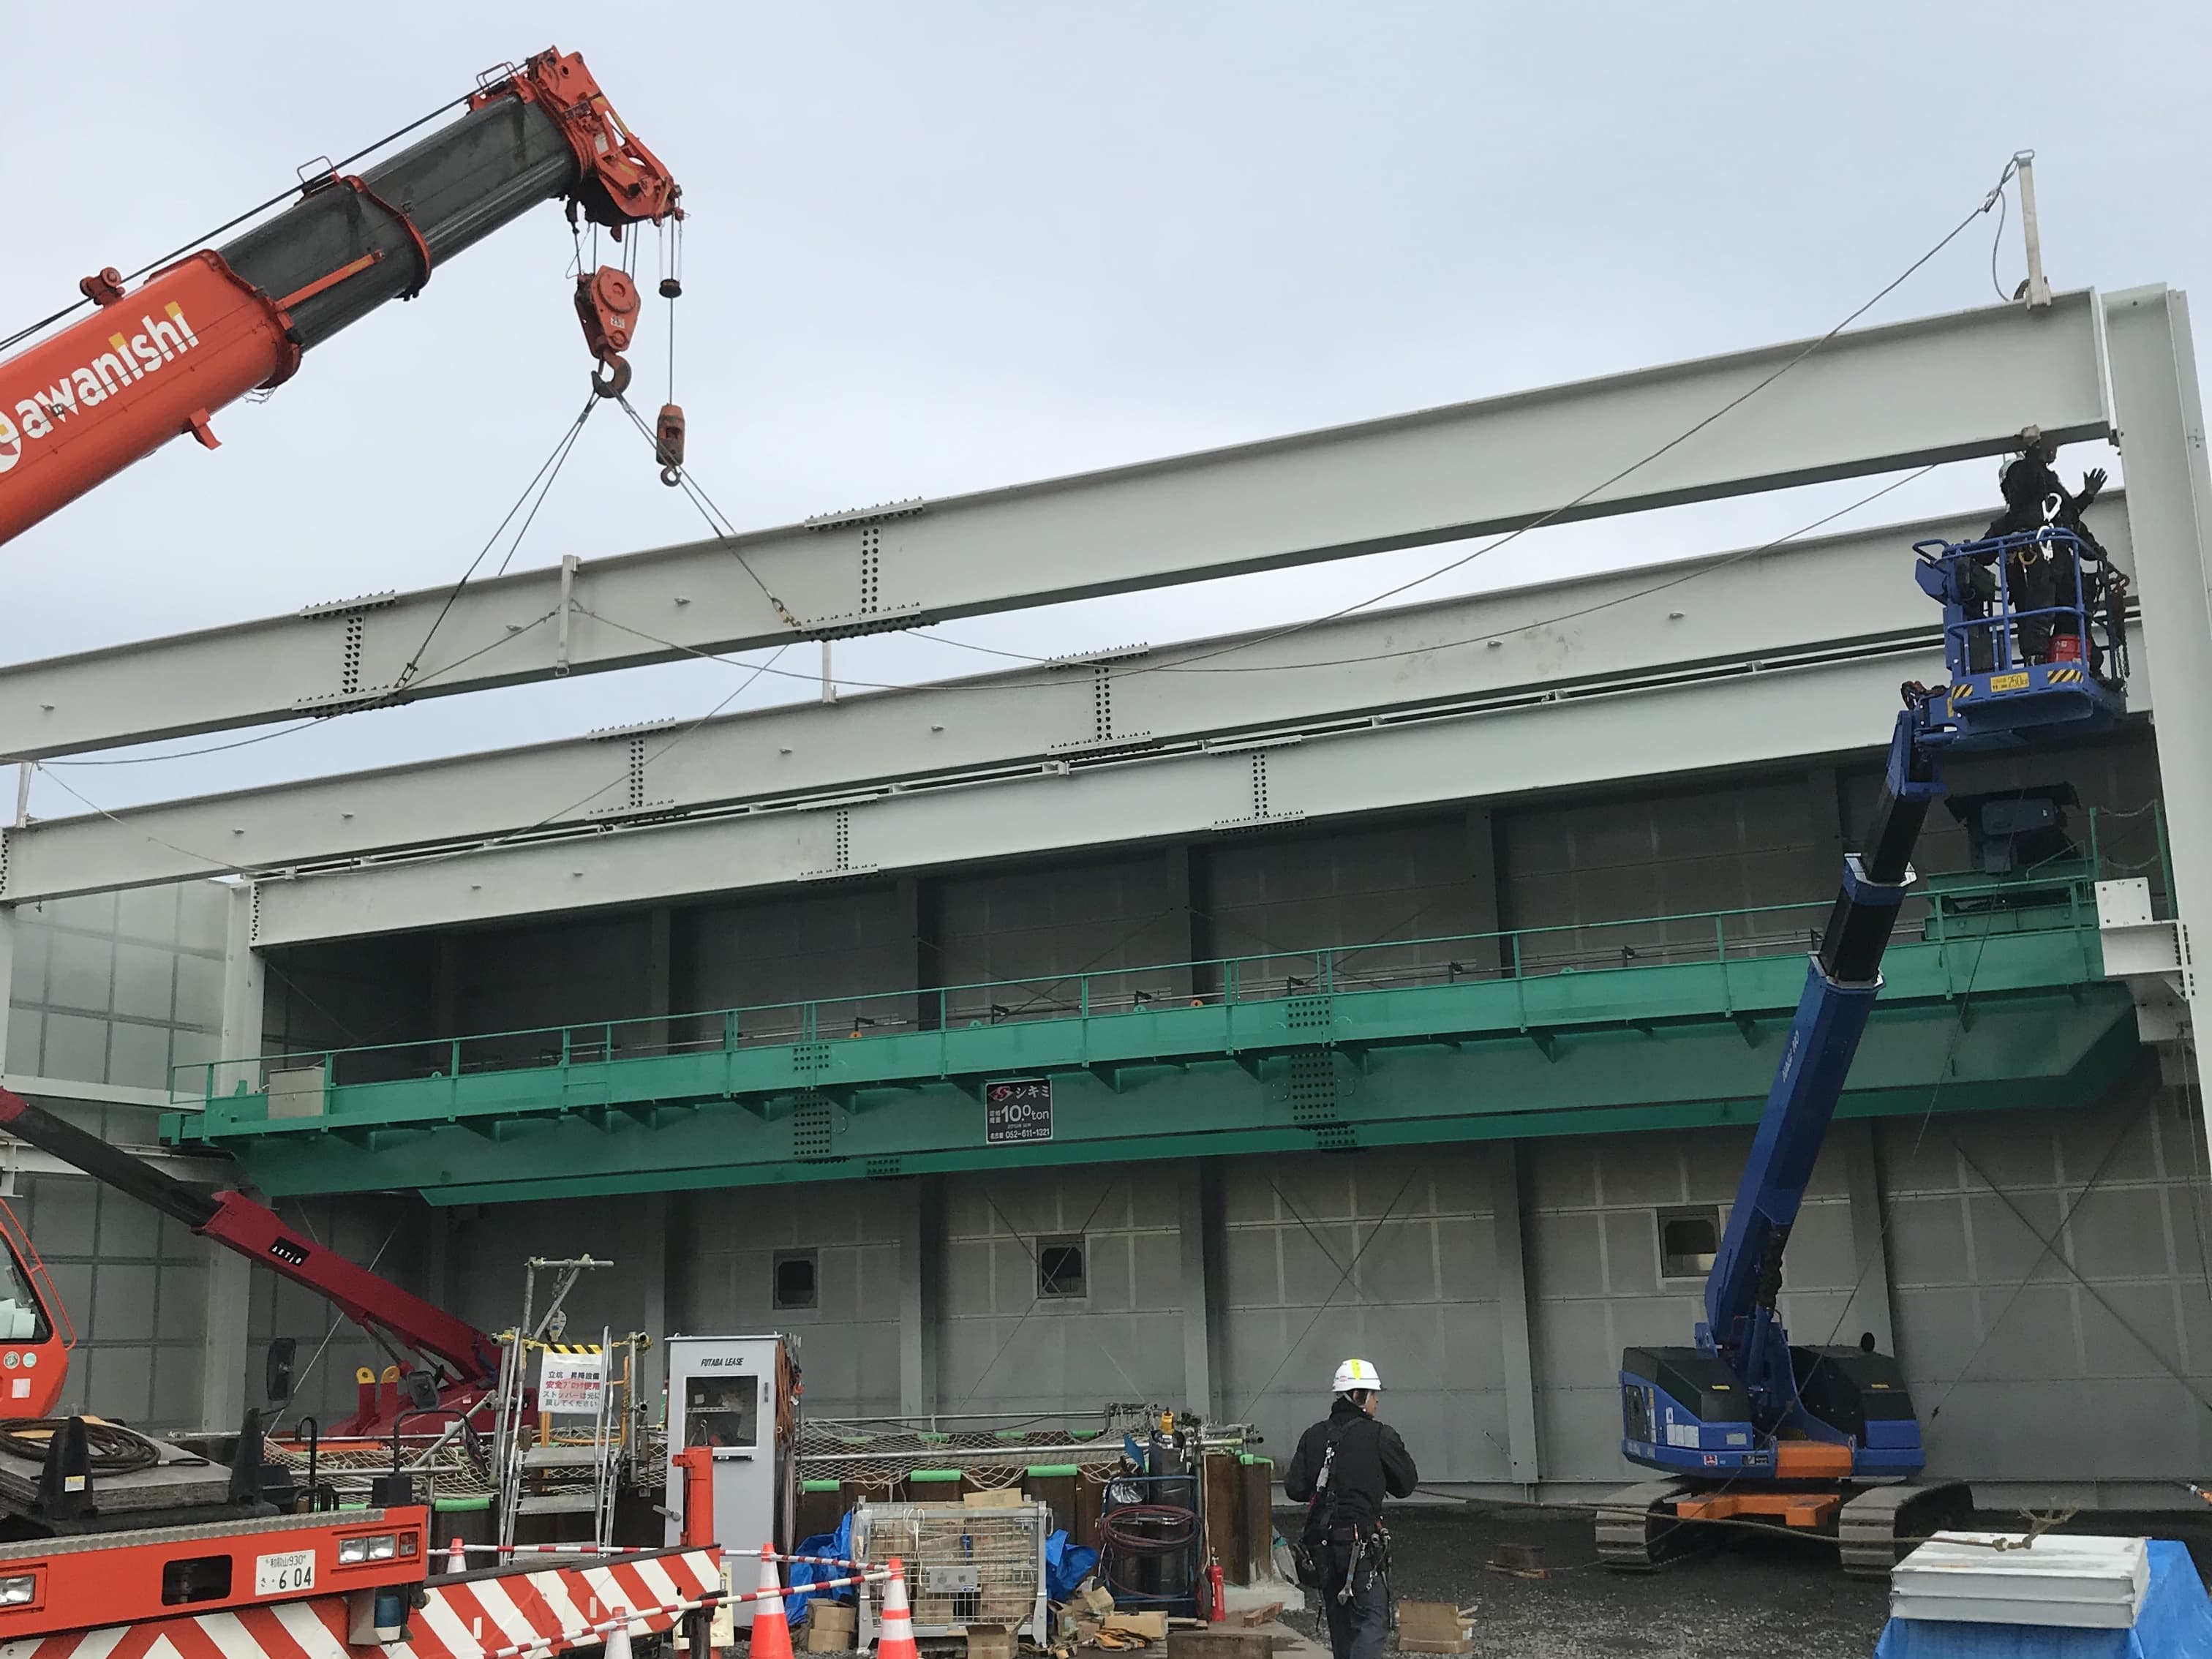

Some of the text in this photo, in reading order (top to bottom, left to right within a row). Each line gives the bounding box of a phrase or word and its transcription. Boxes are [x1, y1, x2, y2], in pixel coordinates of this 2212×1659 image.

[1015, 1085, 1050, 1099] シキミ
[701, 1358, 744, 1366] FUTABA LEASE
